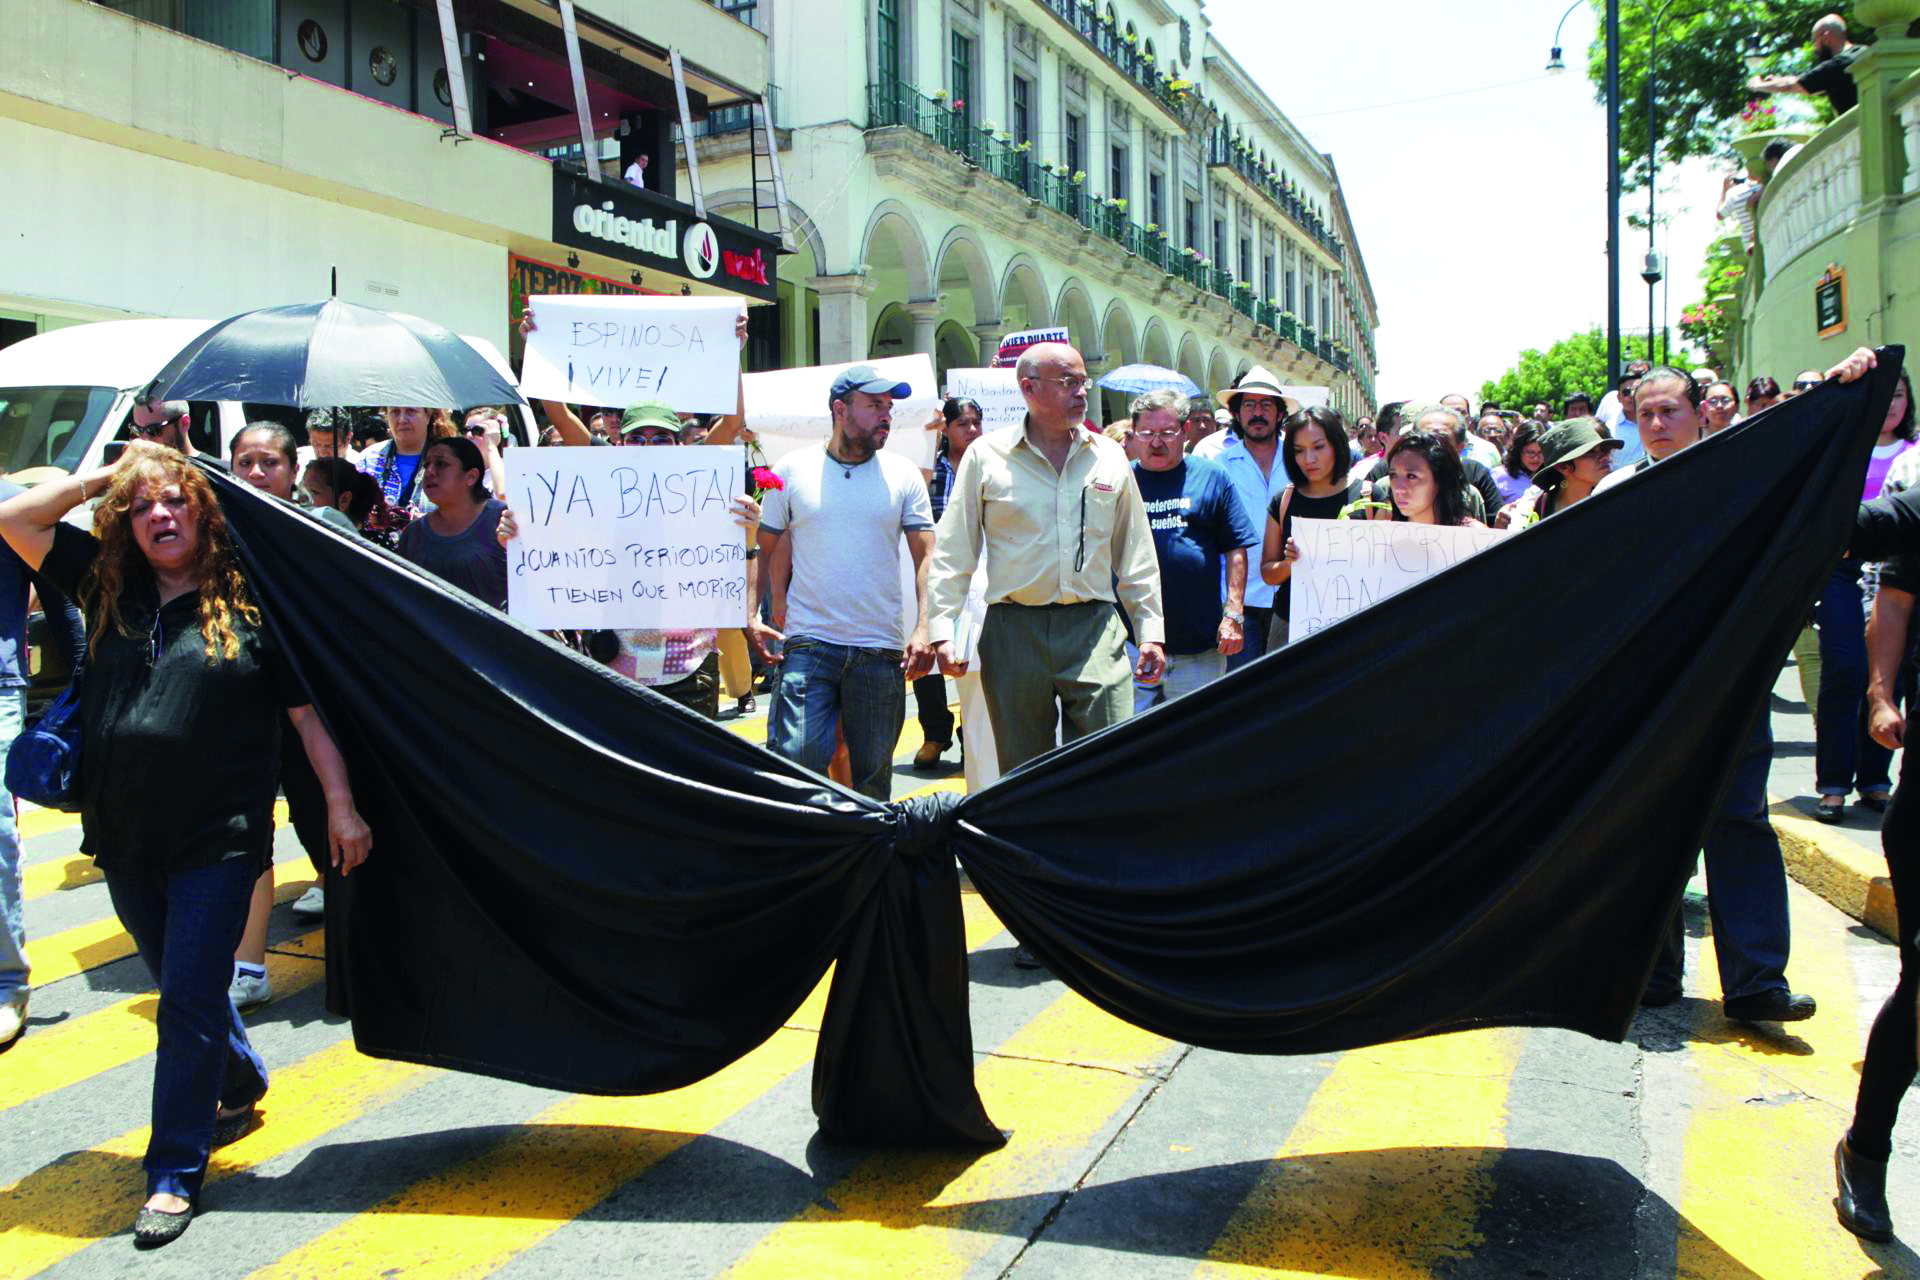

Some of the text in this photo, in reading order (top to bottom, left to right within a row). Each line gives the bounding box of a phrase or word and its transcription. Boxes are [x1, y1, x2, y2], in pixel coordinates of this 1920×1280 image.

[573, 200, 678, 259] oriental
[570, 321, 705, 353] ESPINOSA
[1027, 332, 1064, 345] DUARTE
[957, 378, 977, 396] No
[521, 469, 594, 526] ¡YA
[515, 543, 618, 576] ¿CUANTOS
[547, 581, 623, 604] TIENEN
[631, 580, 671, 600] QUE
